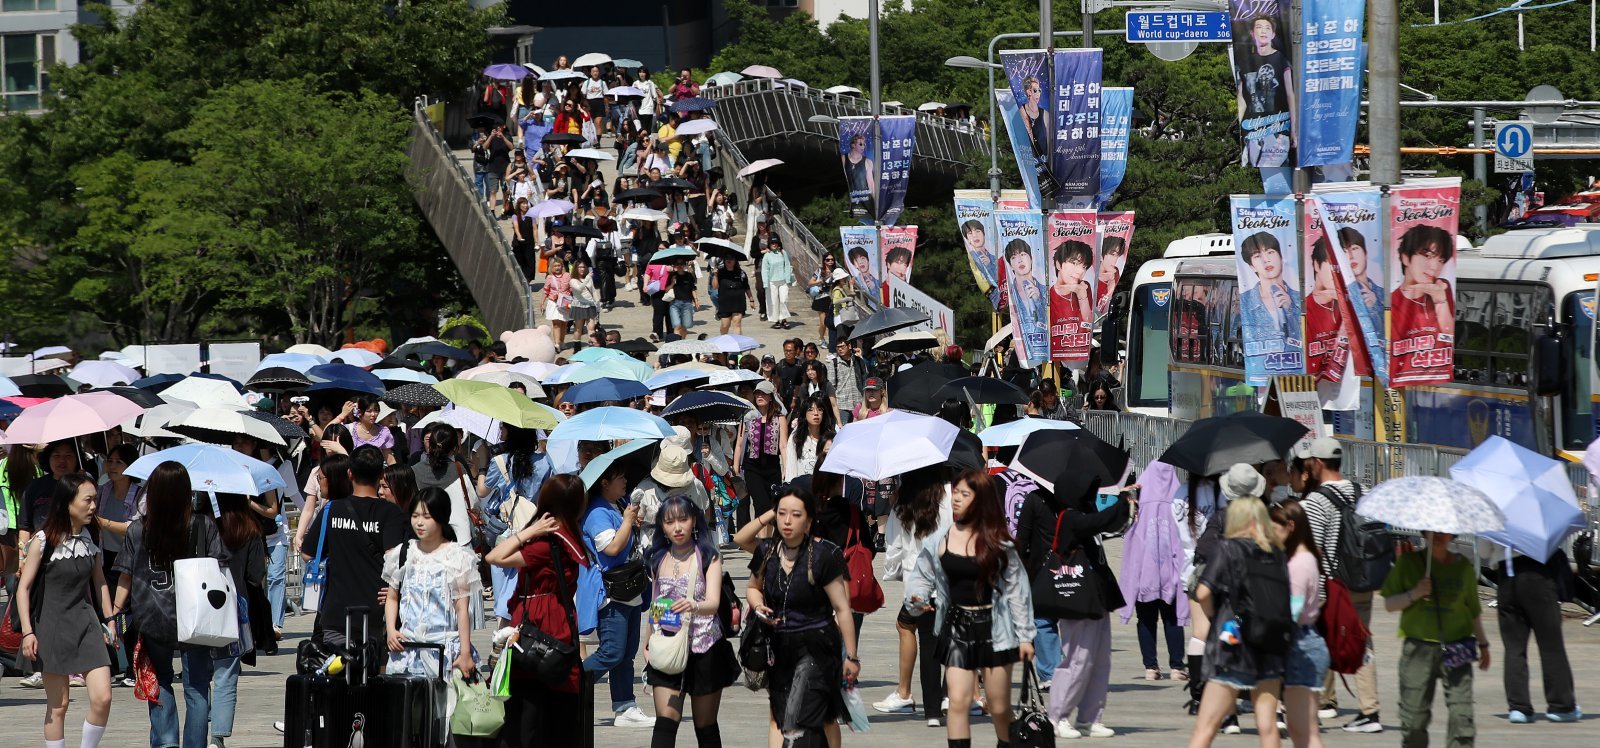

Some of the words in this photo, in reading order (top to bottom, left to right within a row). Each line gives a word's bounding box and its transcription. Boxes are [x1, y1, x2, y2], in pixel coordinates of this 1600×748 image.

[1138, 14, 1208, 29] 월드컵대로
[1137, 30, 1162, 39] World
[1165, 30, 1209, 40] cup-daero
[1306, 38, 1357, 55] 앞으로의
[1305, 76, 1354, 93] 함께할게
[1058, 112, 1099, 127] 13주년
[1339, 203, 1358, 211] with
[1399, 200, 1418, 208] Stay
[1420, 199, 1438, 207] with
[1239, 208, 1255, 217] Stay
[1256, 209, 1273, 217] with
[1264, 352, 1303, 371] 석진!
[1411, 346, 1453, 368] 석진!
[332, 517, 359, 530] HUMA
